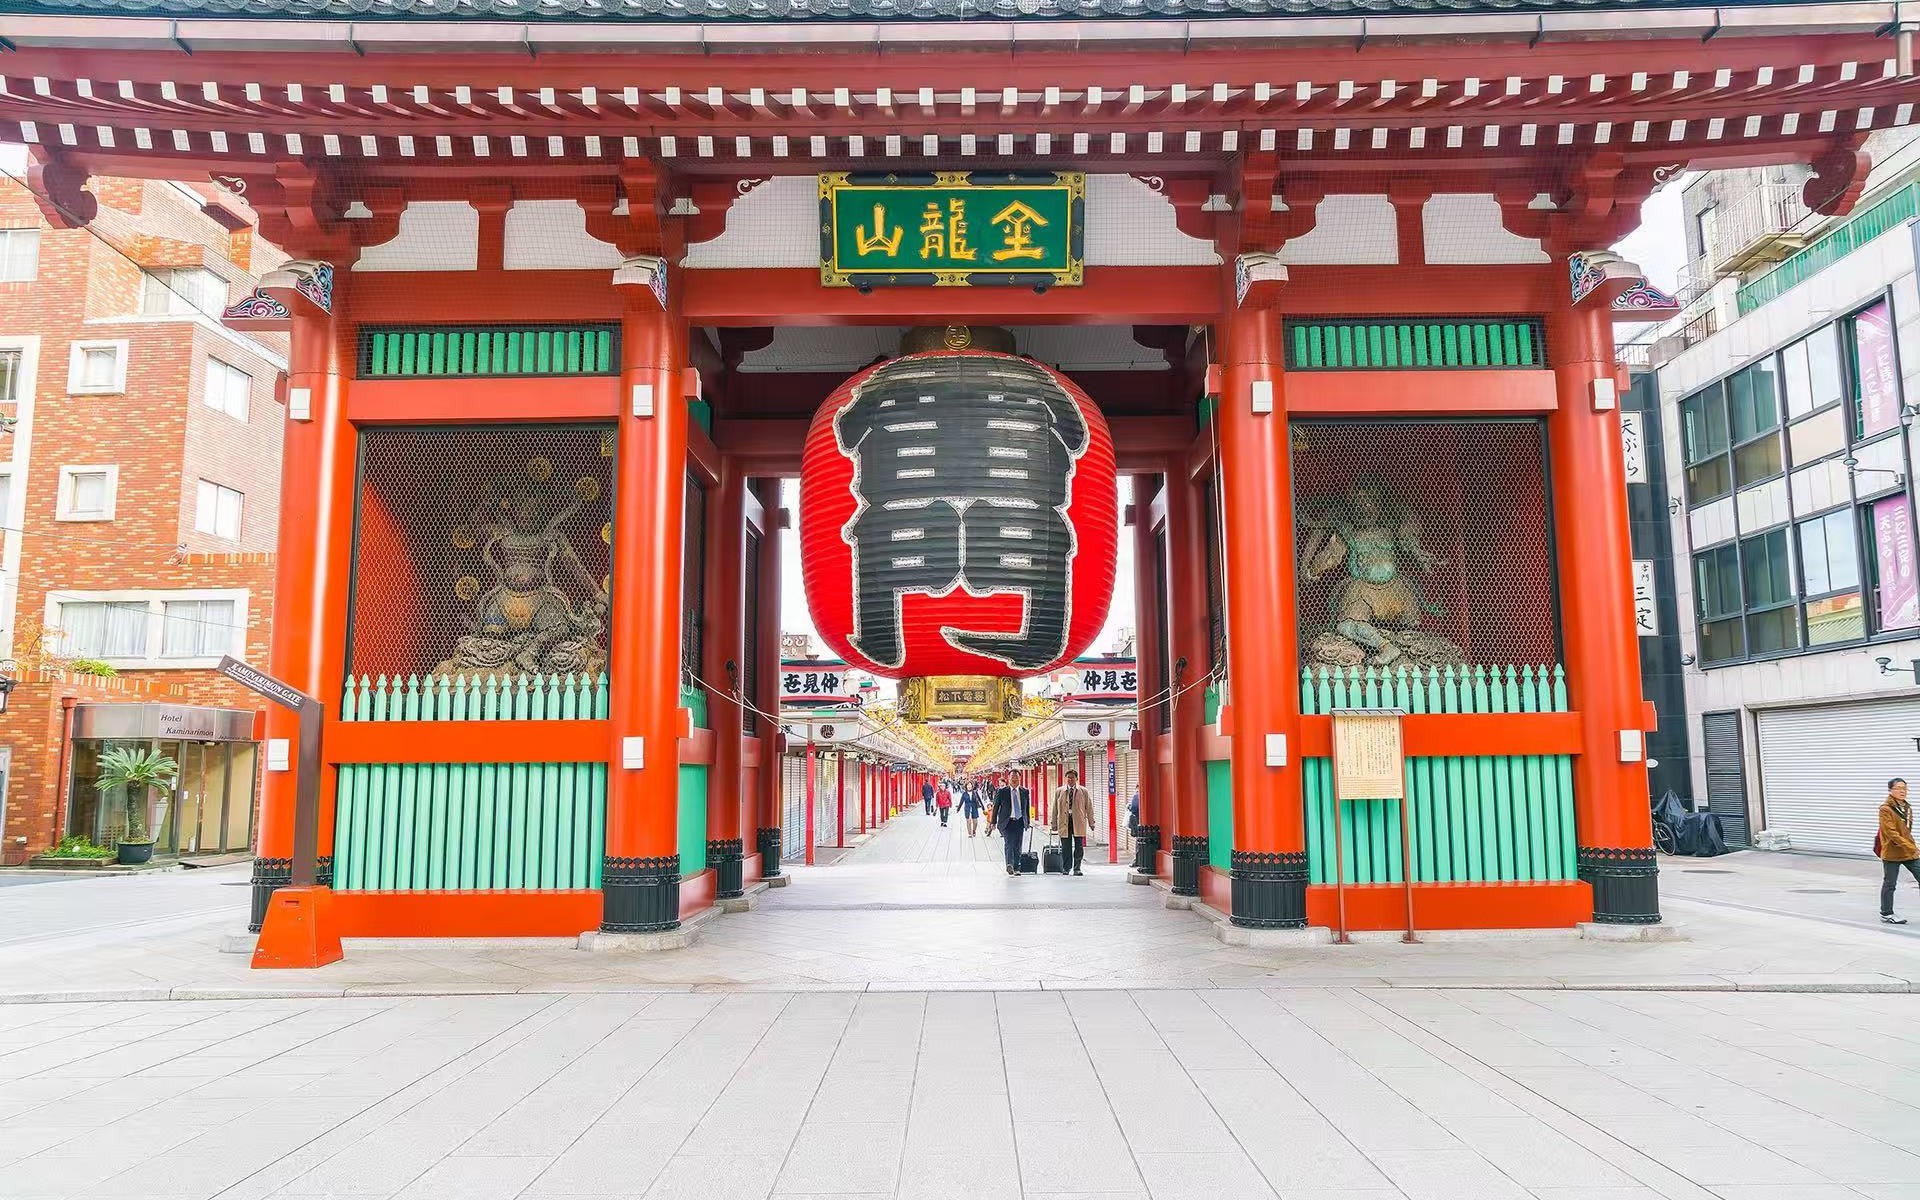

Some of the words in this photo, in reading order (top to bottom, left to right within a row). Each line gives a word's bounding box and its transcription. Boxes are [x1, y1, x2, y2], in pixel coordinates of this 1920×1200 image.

[855, 197, 1049, 261] 金龍山
[1621, 418, 1639, 476] 天ぷら
[832, 355, 1091, 670] 雷門
[1635, 586, 1654, 630] 三定
[230, 662, 283, 695] KAMINARIMON
[281, 687, 303, 704] GATE
[938, 690, 985, 702] 松下電器
[160, 713, 183, 722] Hotel
[165, 727, 214, 737] Kaminarimon
